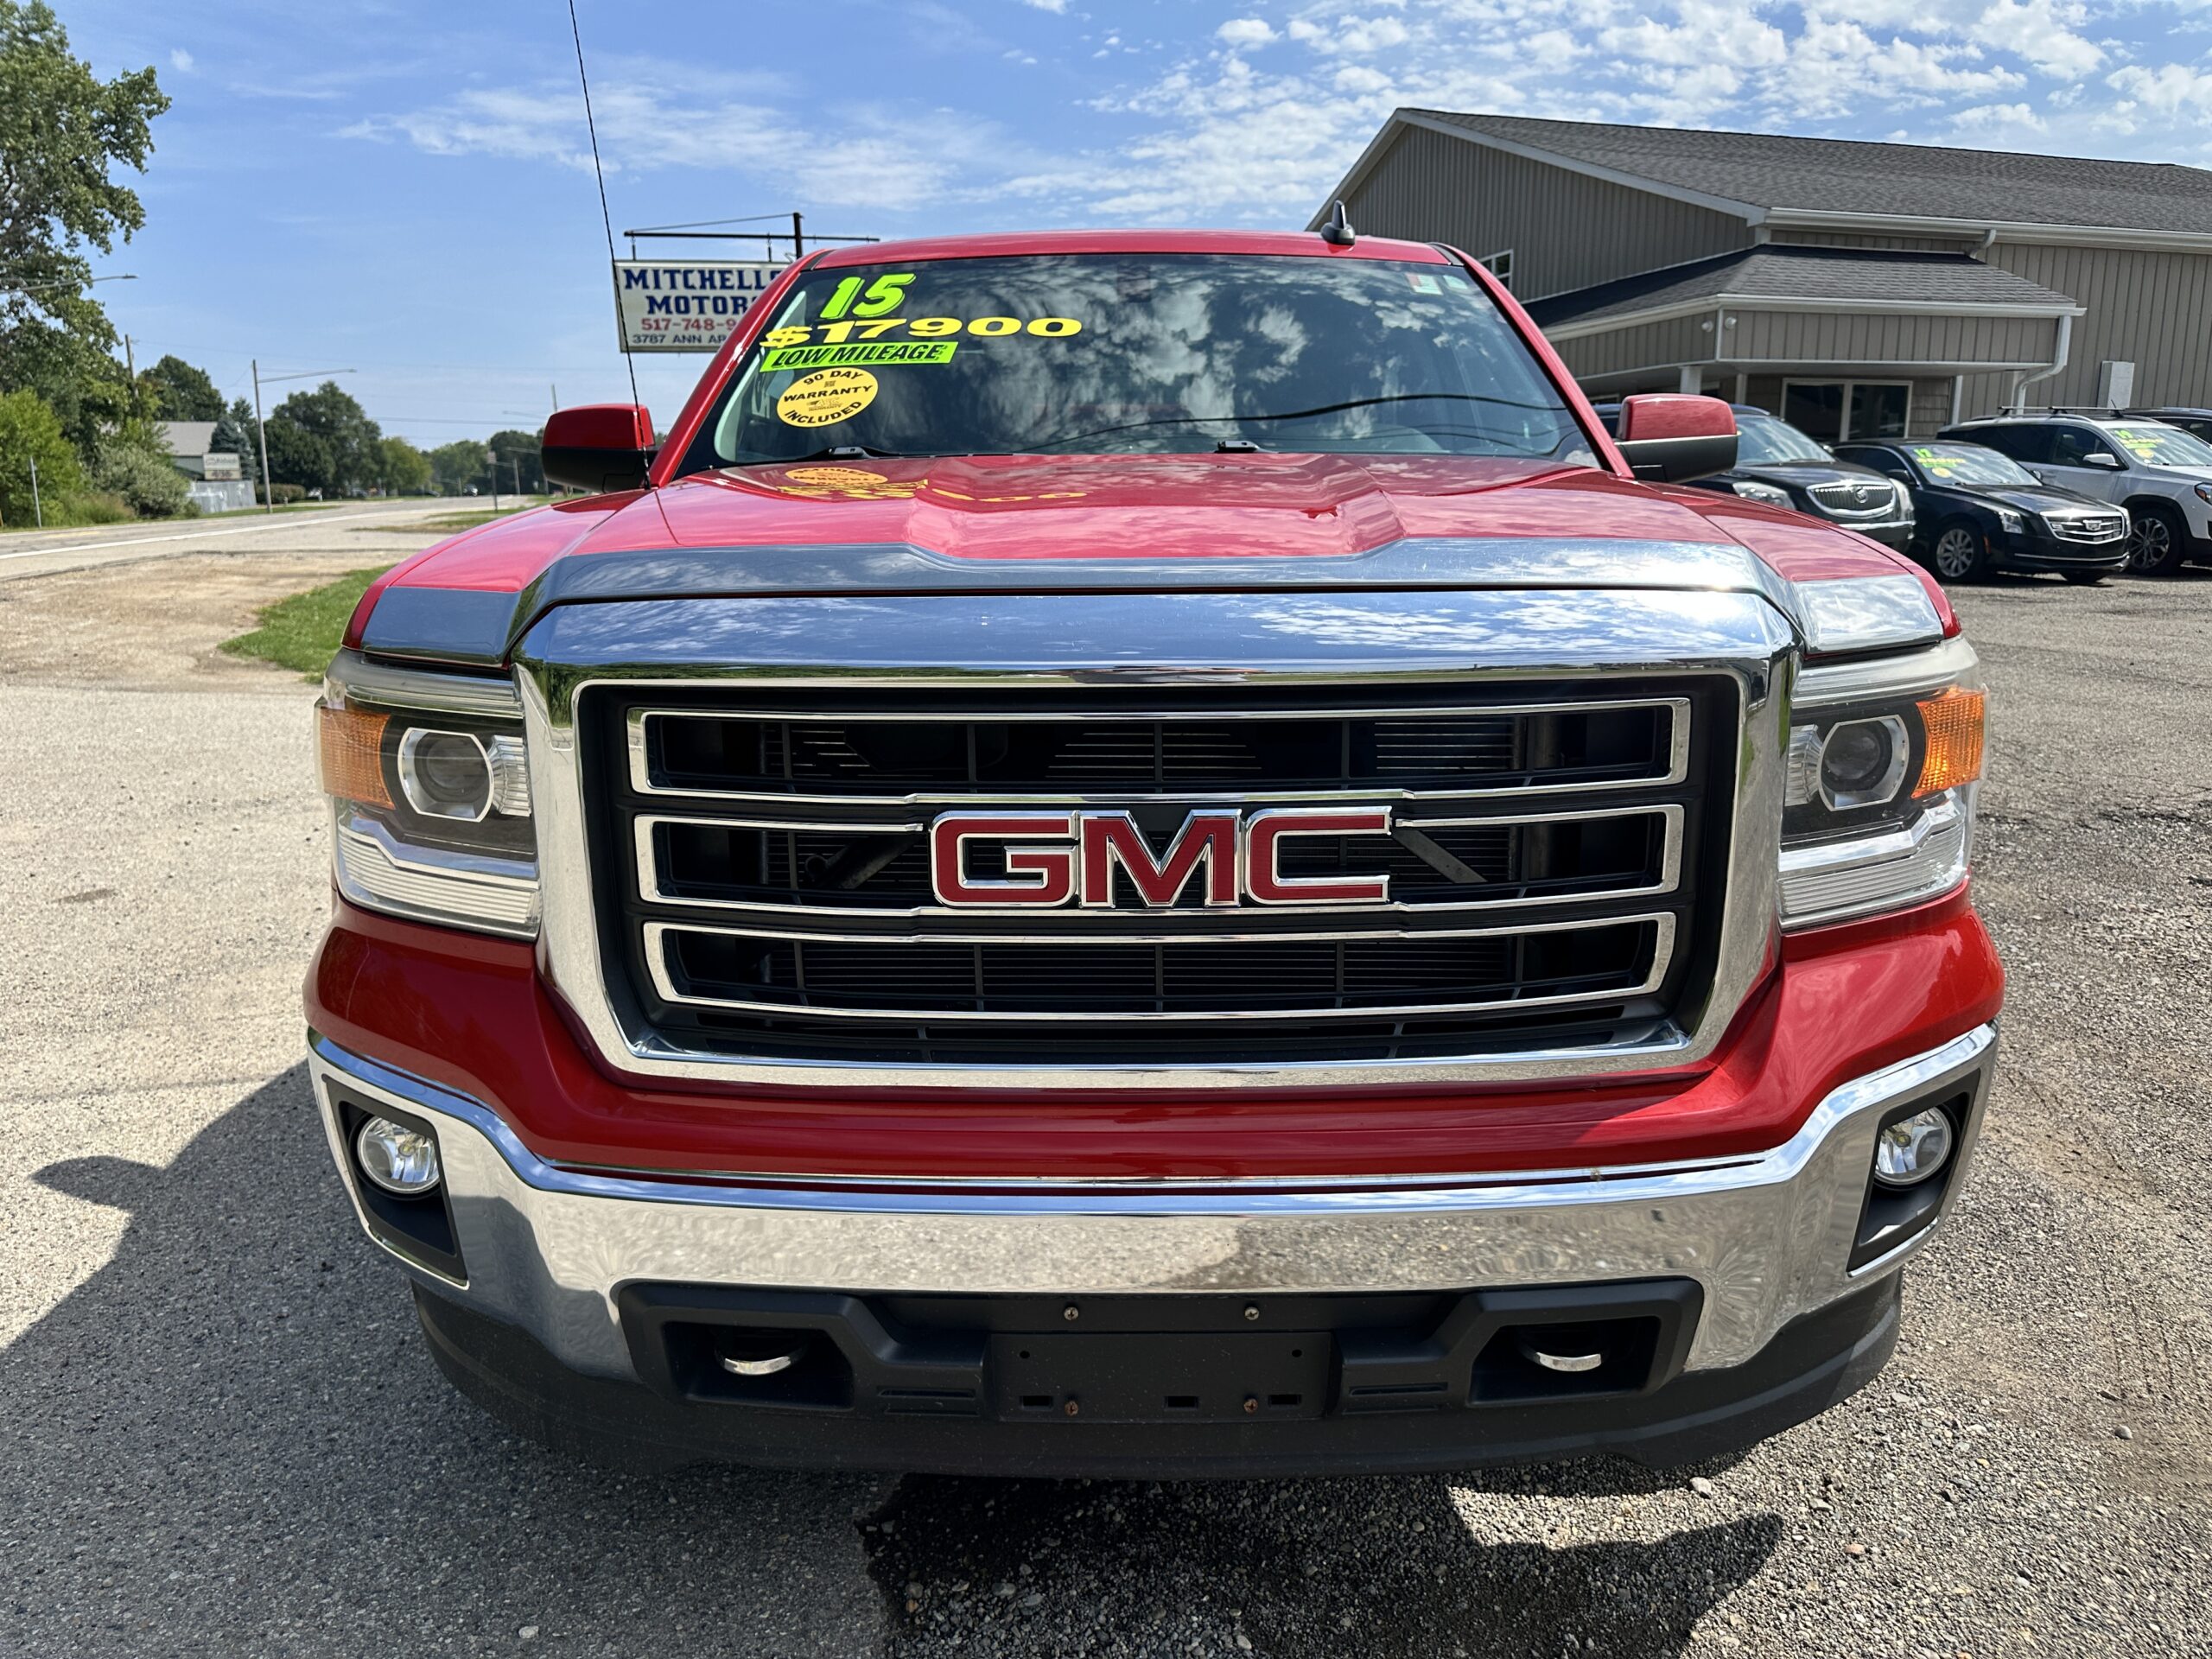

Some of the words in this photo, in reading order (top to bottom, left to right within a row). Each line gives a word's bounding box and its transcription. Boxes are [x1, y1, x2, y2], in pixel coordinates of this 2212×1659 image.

[645, 296, 758, 315] MOTOR
[819, 273, 917, 319] 15
[641, 318, 737, 331] 517-748-9
[760, 317, 1083, 347] $17900
[632, 334, 666, 344] 3787
[672, 334, 702, 344] ANN
[772, 347, 831, 369] LOW
[828, 344, 948, 365] MILEAGE
[804, 373, 824, 385] 90
[830, 370, 864, 379] DAY
[784, 385, 874, 402] WARRANTY
[785, 402, 862, 424] INCLUDED
[930, 806, 1392, 908] GMC
